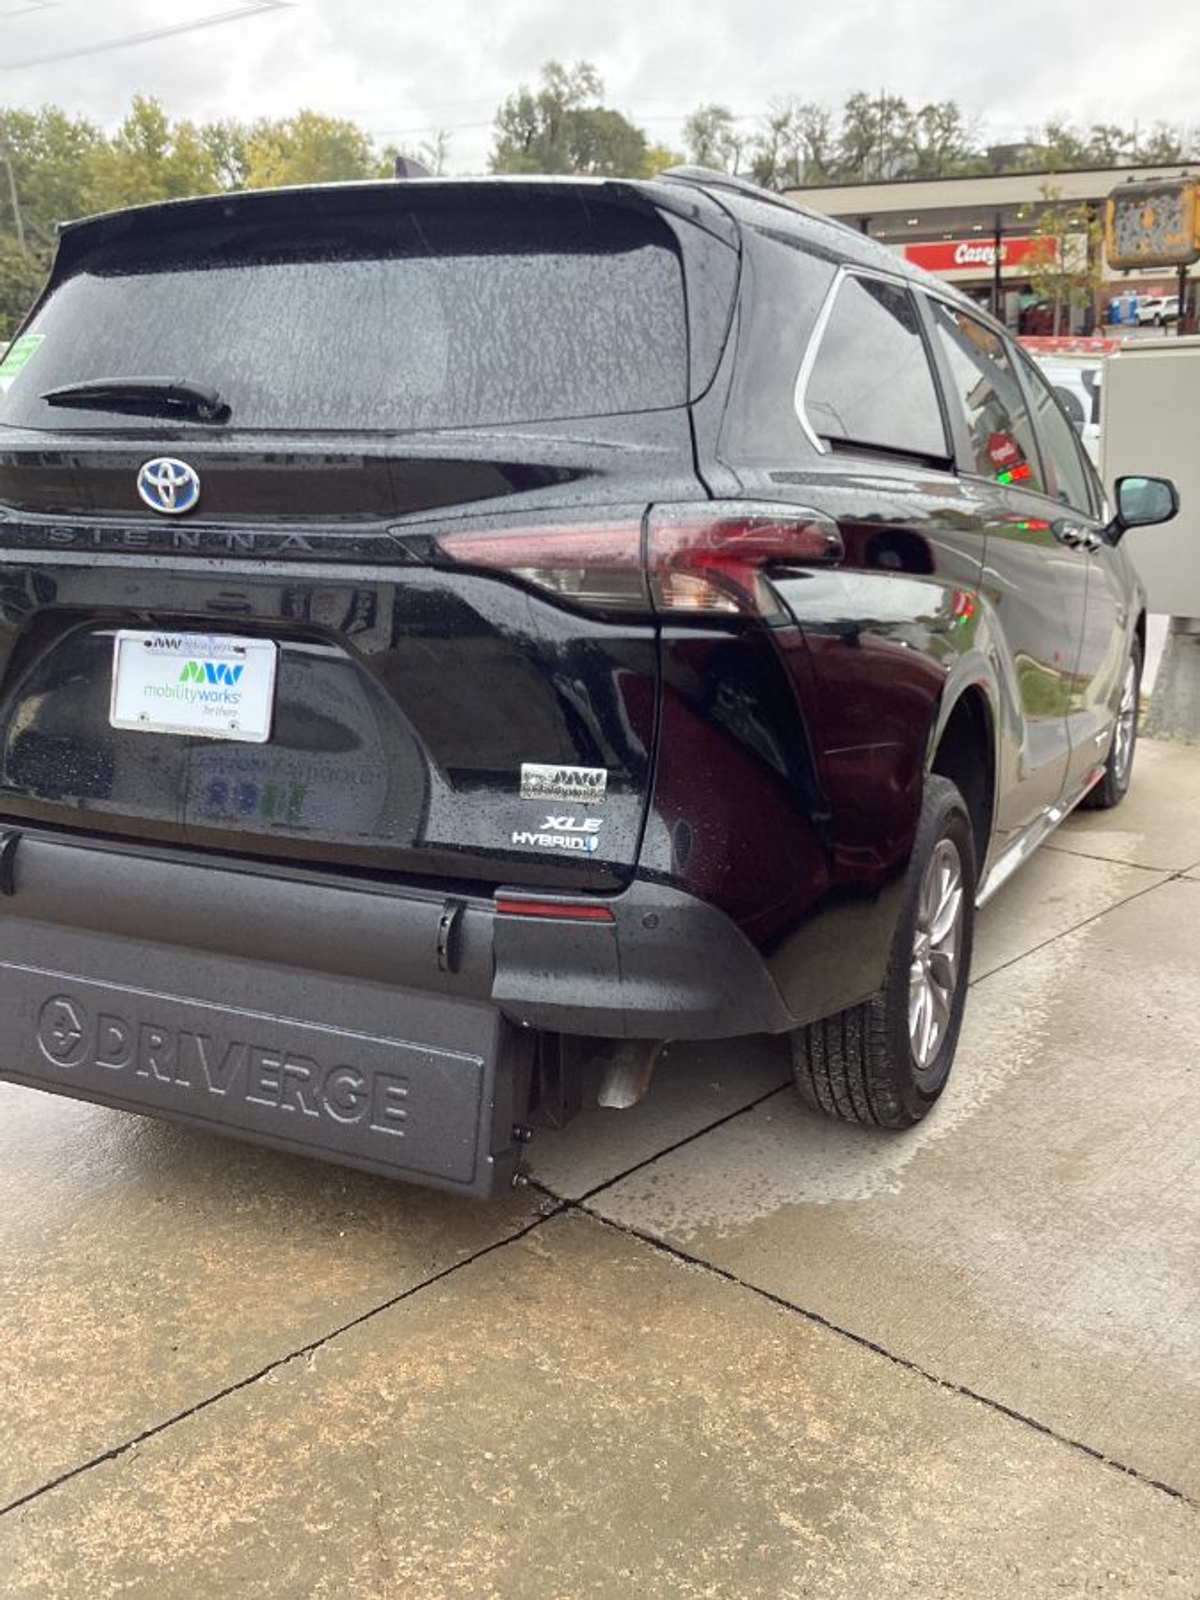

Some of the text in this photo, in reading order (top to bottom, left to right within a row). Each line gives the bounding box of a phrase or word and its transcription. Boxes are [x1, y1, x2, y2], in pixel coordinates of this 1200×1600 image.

[50, 526, 313, 554] SIENNA
[540, 816, 603, 833] XLE
[512, 832, 584, 850] HYBRID
[96, 1012, 410, 1136] DRIVERGE
